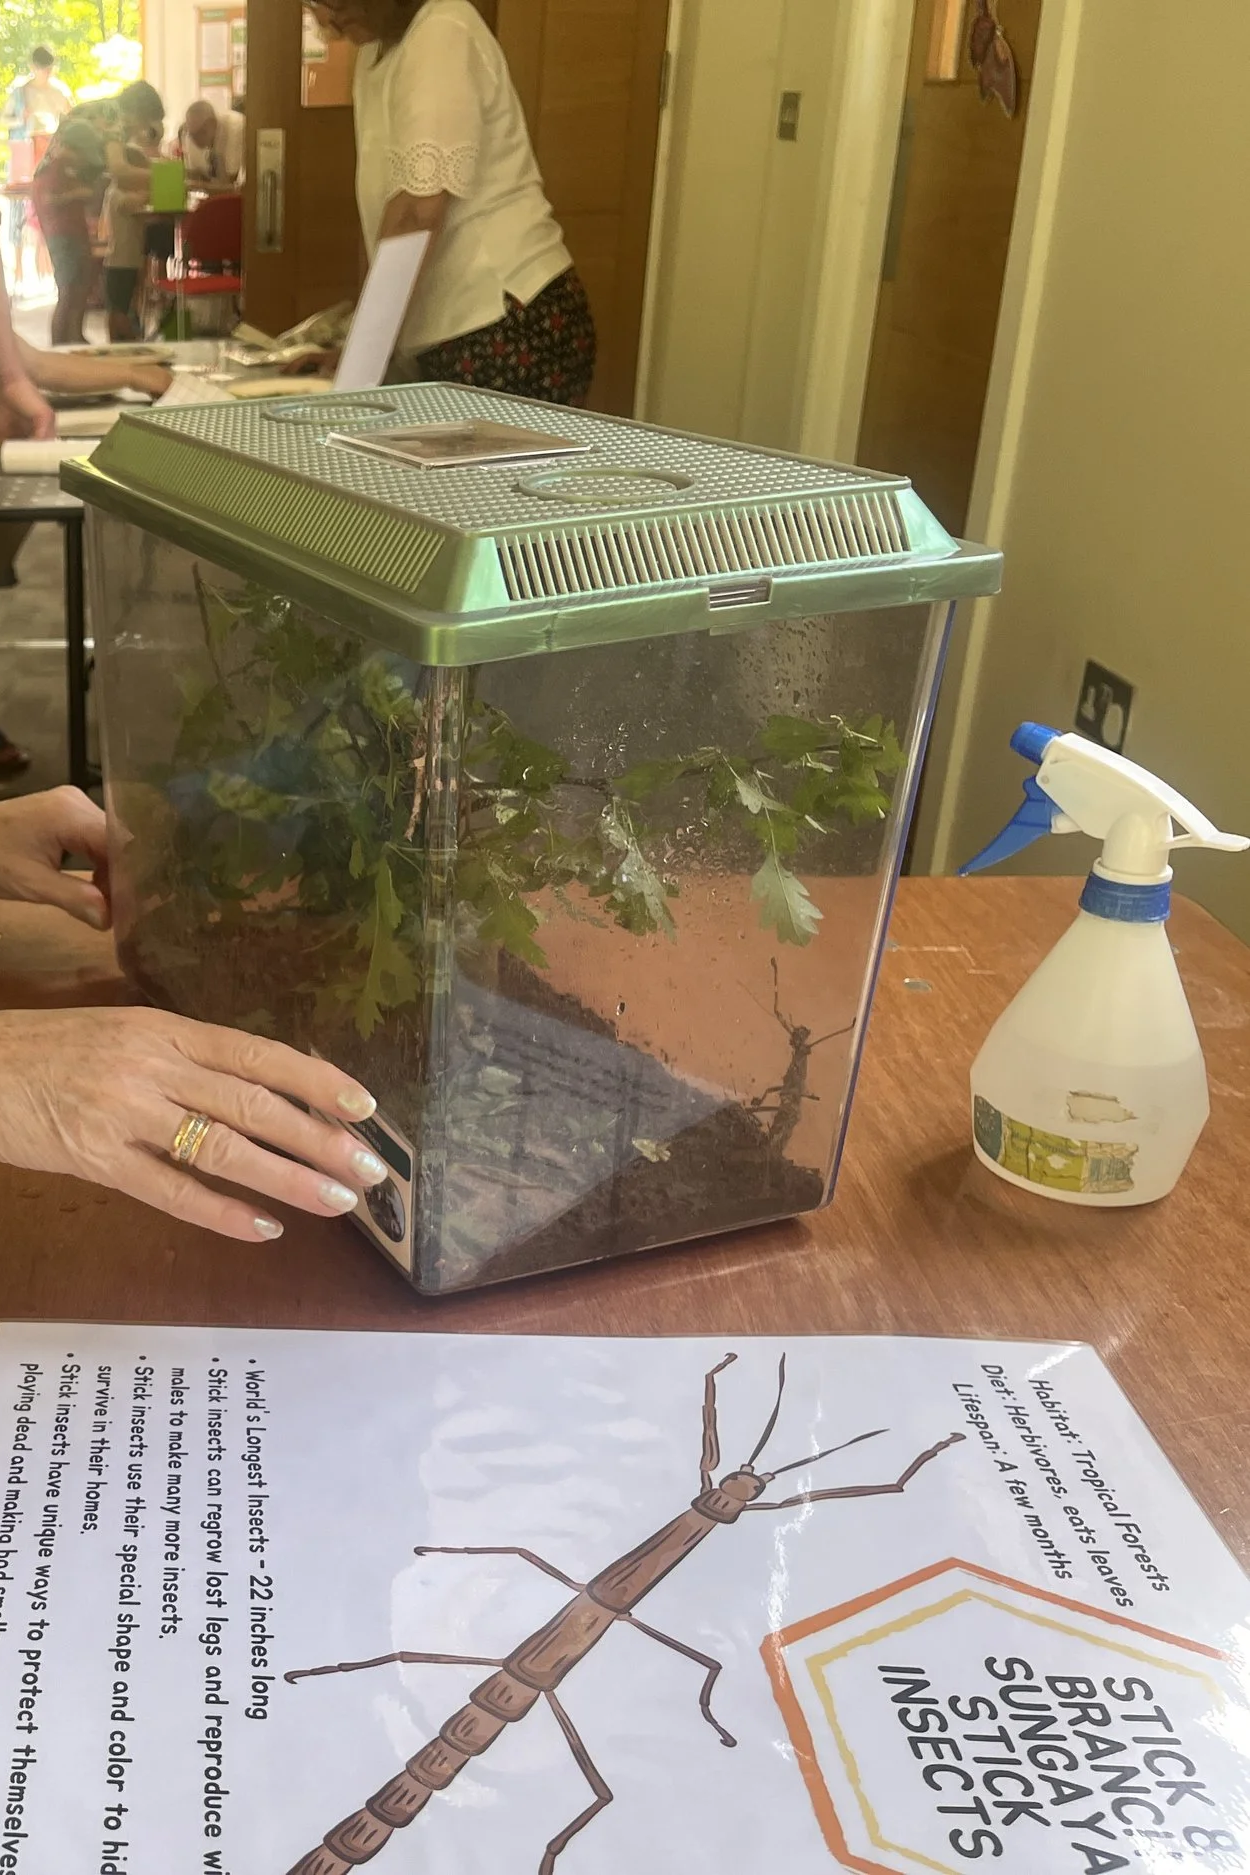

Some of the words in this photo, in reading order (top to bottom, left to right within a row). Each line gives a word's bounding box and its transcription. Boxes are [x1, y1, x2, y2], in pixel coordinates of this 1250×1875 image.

[14, 1364, 43, 1411] playing
[59, 1364, 81, 1398] Stick
[94, 1366, 114, 1416] survive
[133, 1367, 154, 1400] Stick
[171, 1368, 190, 1405] males
[208, 1369, 228, 1402] Stick
[246, 1371, 270, 1422] World's
[13, 1417, 36, 1450] dead
[51, 1404, 76, 1455] insects
[93, 1421, 112, 1432] in
[129, 1406, 151, 1457] insects
[170, 1411, 188, 1426] to
[208, 1409, 227, 1461] insects
[952, 1384, 1007, 1454] Lifespan:
[8, 1456, 28, 1484] and
[88, 1438, 110, 1476] their
[168, 1432, 188, 1468] make
[241, 1428, 267, 1488] Longest
[994, 1460, 1018, 1472] A
[46, 1462, 70, 1497] have
[127, 1464, 142, 1489] use
[160, 1474, 181, 1514] many
[208, 1469, 222, 1496] can
[981, 1365, 1016, 1400] Diet:
[1004, 1405, 1067, 1499] Herbivores,
[1064, 1506, 1096, 1543] eats
[1087, 1550, 1133, 1606] leaves
[1005, 1479, 1033, 1508] few
[1029, 1380, 1082, 1443] Habitat:
[1072, 1450, 1132, 1517] Tropical
[1114, 1523, 1169, 1591] Forests
[81, 1482, 108, 1534] homes.
[124, 1497, 146, 1537] their
[248, 1495, 269, 1552] Insects
[38, 1505, 62, 1557] unique
[164, 1521, 180, 1561] more
[200, 1504, 222, 1563] regrow
[1024, 1515, 1072, 1579] months
[28, 1565, 51, 1610] ways
[116, 1545, 141, 1605] special
[206, 1572, 228, 1608] lost
[250, 1575, 273, 1600] 22
[159, 1568, 185, 1638] insects.
[27, 1619, 50, 1641] to
[109, 1614, 140, 1672] shape
[199, 1617, 229, 1655] legs
[251, 1607, 274, 1667] inches
[16, 1650, 42, 1734] protect
[111, 1681, 135, 1721] and
[205, 1666, 229, 1704] and
[245, 1675, 275, 1719] long
[107, 1731, 132, 1792] color
[878, 1666, 1003, 1858] INSECTS
[948, 1695, 1051, 1826] STICK
[1103, 1677, 1214, 1806] STICK
[197, 1716, 230, 1837] reproduce
[985, 1657, 1129, 1875] SUNGAYA
[104, 1803, 128, 1830] to
